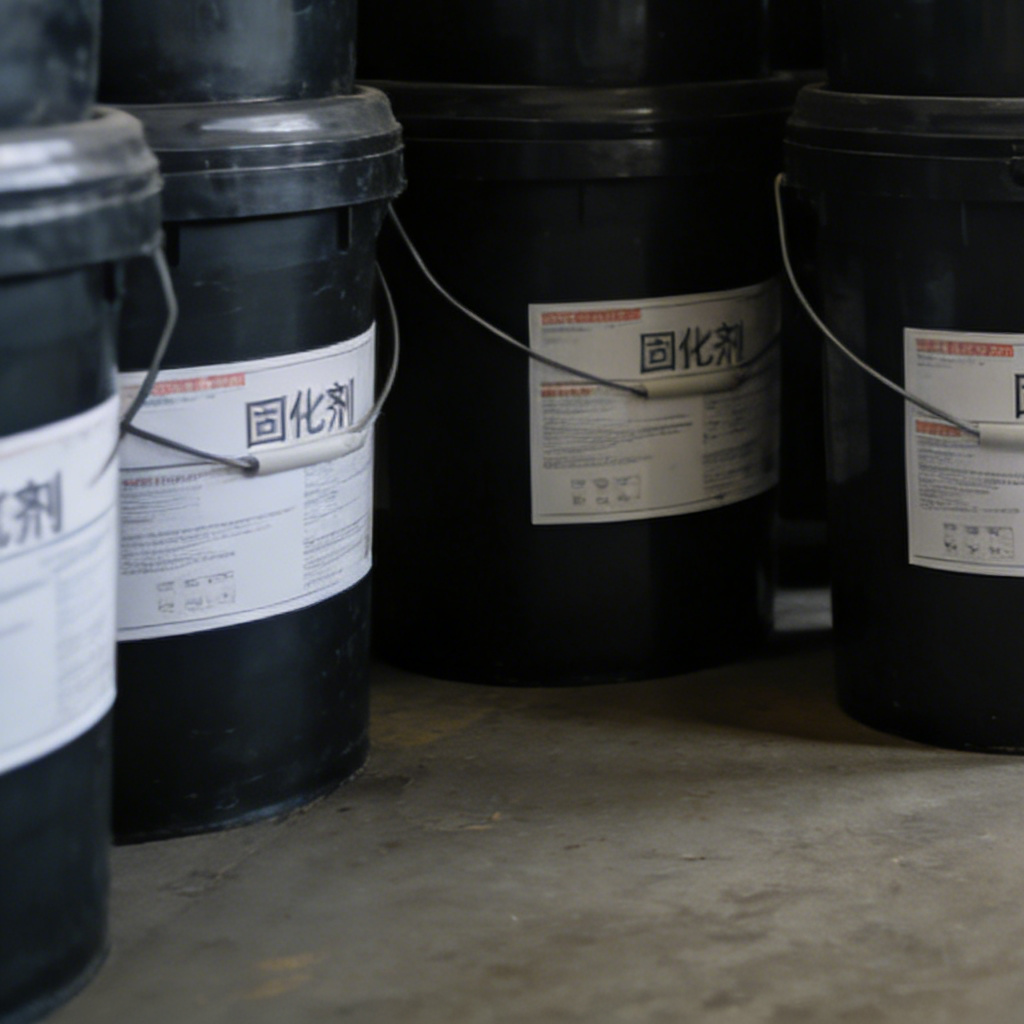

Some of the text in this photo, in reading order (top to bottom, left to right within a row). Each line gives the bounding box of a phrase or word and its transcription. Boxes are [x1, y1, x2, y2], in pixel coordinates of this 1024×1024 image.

[640, 320, 744, 374] 固化剂
[246, 378, 354, 448] 固化剂
